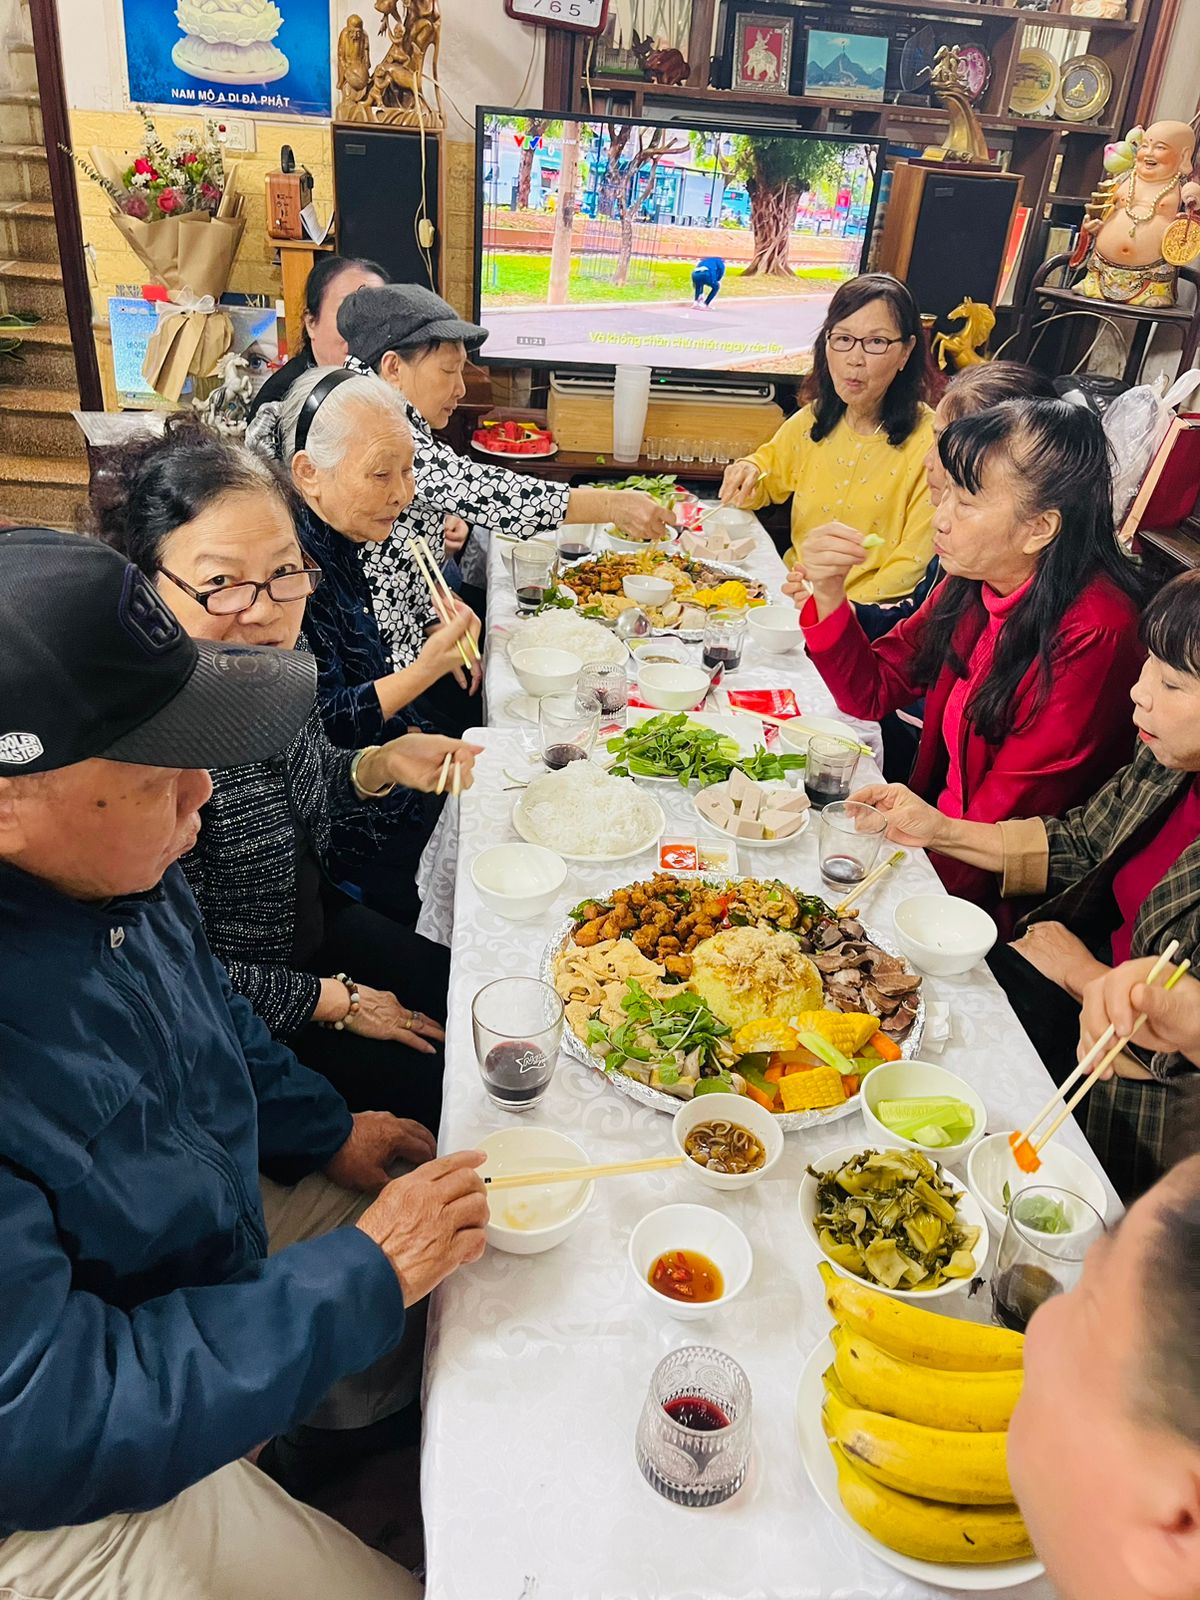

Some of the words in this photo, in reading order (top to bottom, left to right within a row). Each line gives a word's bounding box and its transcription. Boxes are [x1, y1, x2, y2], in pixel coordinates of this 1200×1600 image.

[171, 88, 196, 100] NAM
[198, 89, 215, 101] MÔ
[217, 92, 226, 103] A
[228, 93, 240, 103] DI
[241, 92, 258, 105] ĐÀ
[260, 95, 290, 109] PHẬT
[513, 135, 543, 150] VTV1
[0, 734, 39, 751] OOLER
